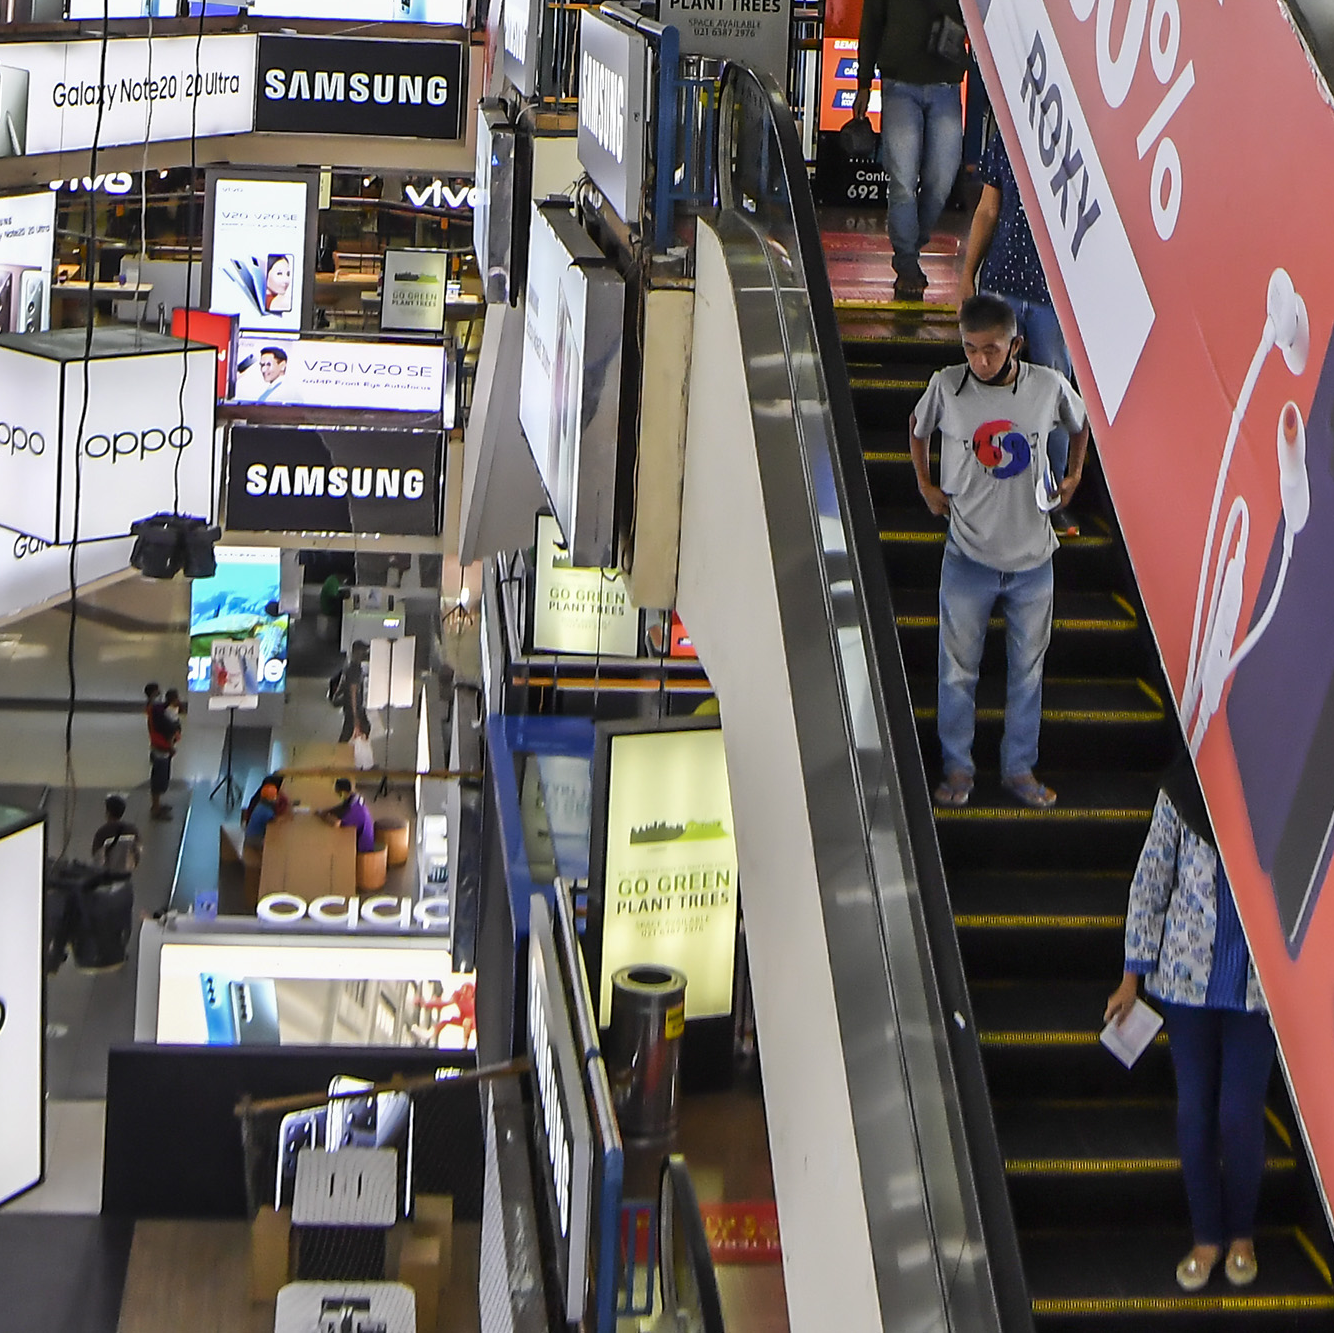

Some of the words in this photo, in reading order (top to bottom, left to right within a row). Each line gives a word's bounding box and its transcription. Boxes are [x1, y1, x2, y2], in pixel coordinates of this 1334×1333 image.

[688, 19, 714, 27] SPACE
[717, 20, 762, 29] AVAILABLE
[694, 28, 709, 36] 021
[734, 29, 756, 38] 2976
[52, 80, 118, 110] Galaxy
[120, 77, 177, 105] Note20
[204, 72, 240, 96] Ultra
[265, 69, 448, 106] SAMSUNG
[581, 50, 625, 164] SAMSUNG
[1020, 30, 1102, 262] ROXY
[847, 185, 879, 200] 692
[304, 360, 348, 374] V20
[358, 362, 402, 376] V20
[407, 365, 433, 377] SE
[85, 425, 193, 464] oppo
[246, 463, 425, 500] SAMSUNG
[549, 587, 572, 601] GO
[575, 588, 626, 604] GREEN
[549, 601, 585, 614] PLANT
[588, 603, 625, 616] TREES
[618, 877, 649, 897] GO
[657, 869, 730, 893] GREEN
[617, 896, 672, 915] PLANT
[678, 890, 730, 910] TREES
